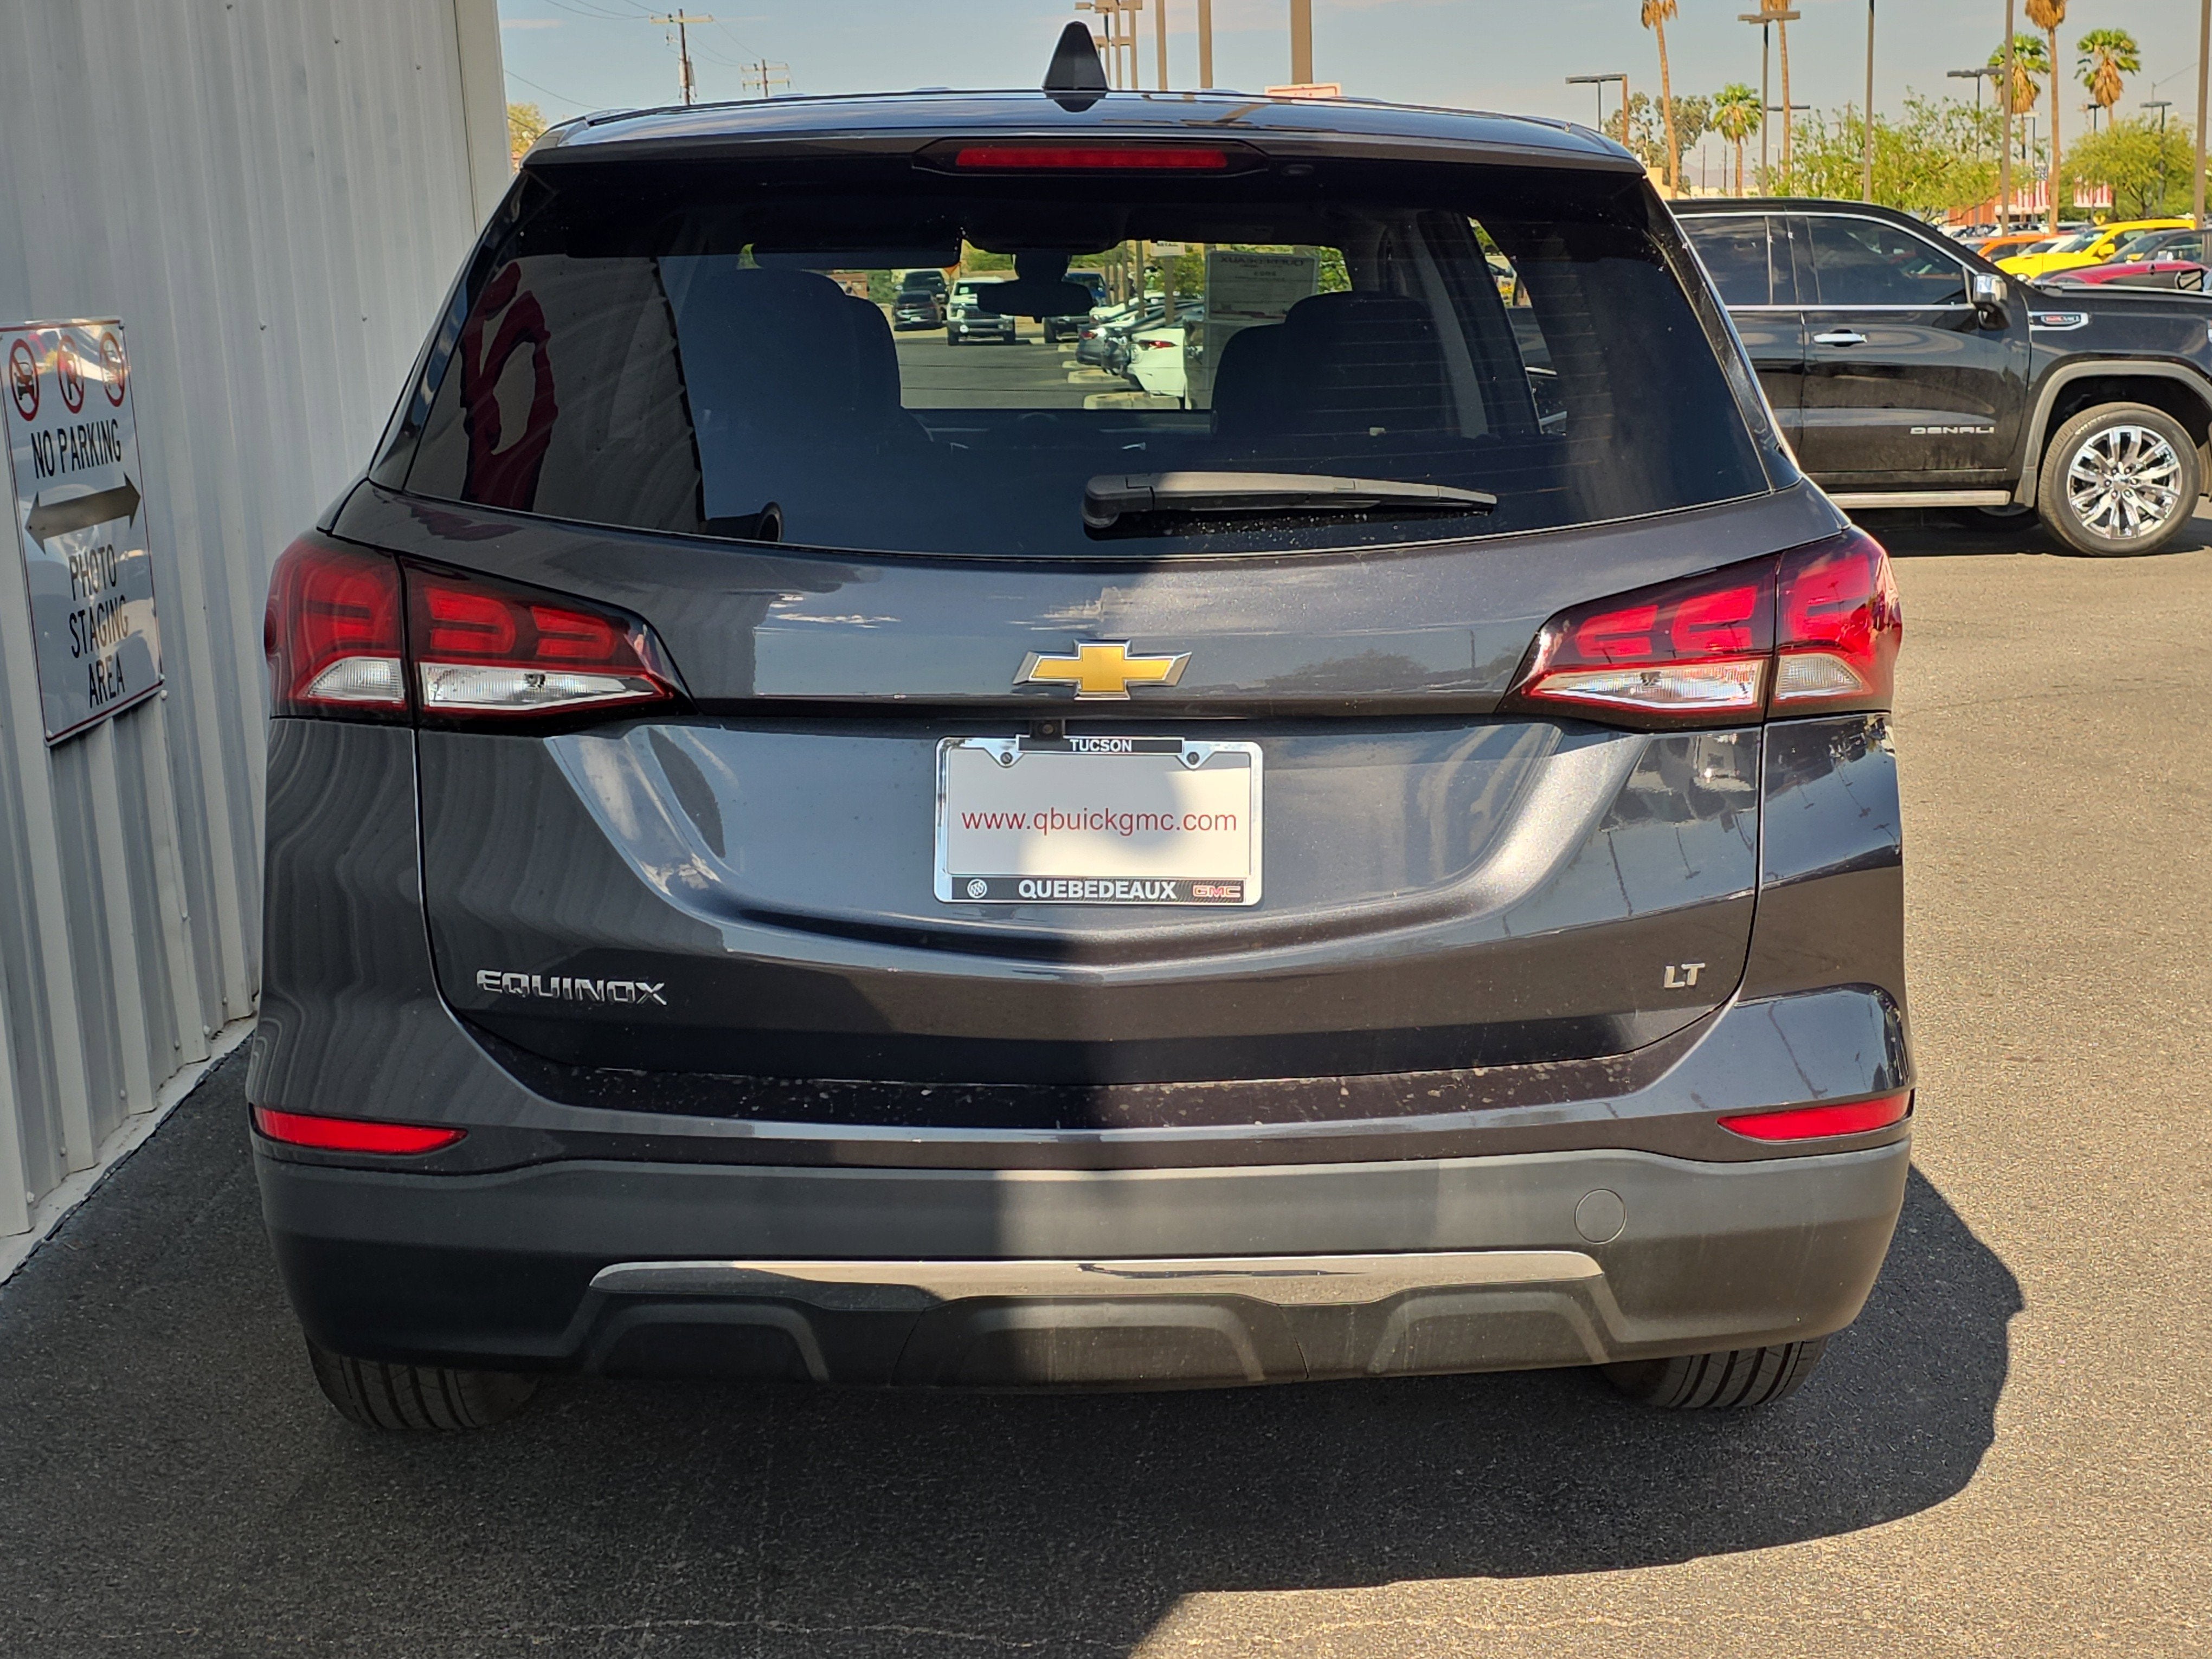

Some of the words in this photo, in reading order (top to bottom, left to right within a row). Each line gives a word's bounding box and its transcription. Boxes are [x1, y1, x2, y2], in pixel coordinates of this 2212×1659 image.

[1910, 426, 1995, 434] DENALI
[31, 429, 55, 479] NO
[57, 418, 121, 473] PARKING
[68, 544, 117, 601] PHOTO
[69, 595, 128, 659] STAGING
[88, 652, 126, 708] AREA
[1070, 738, 1133, 753] TUCSON
[962, 807, 1237, 837] www.qbuickgmc.com
[1019, 879, 1177, 900] QUEBEDEAUX
[1193, 884, 1241, 898] GMC
[477, 969, 667, 1005] EQUINOX
[1664, 963, 1706, 988] LT
